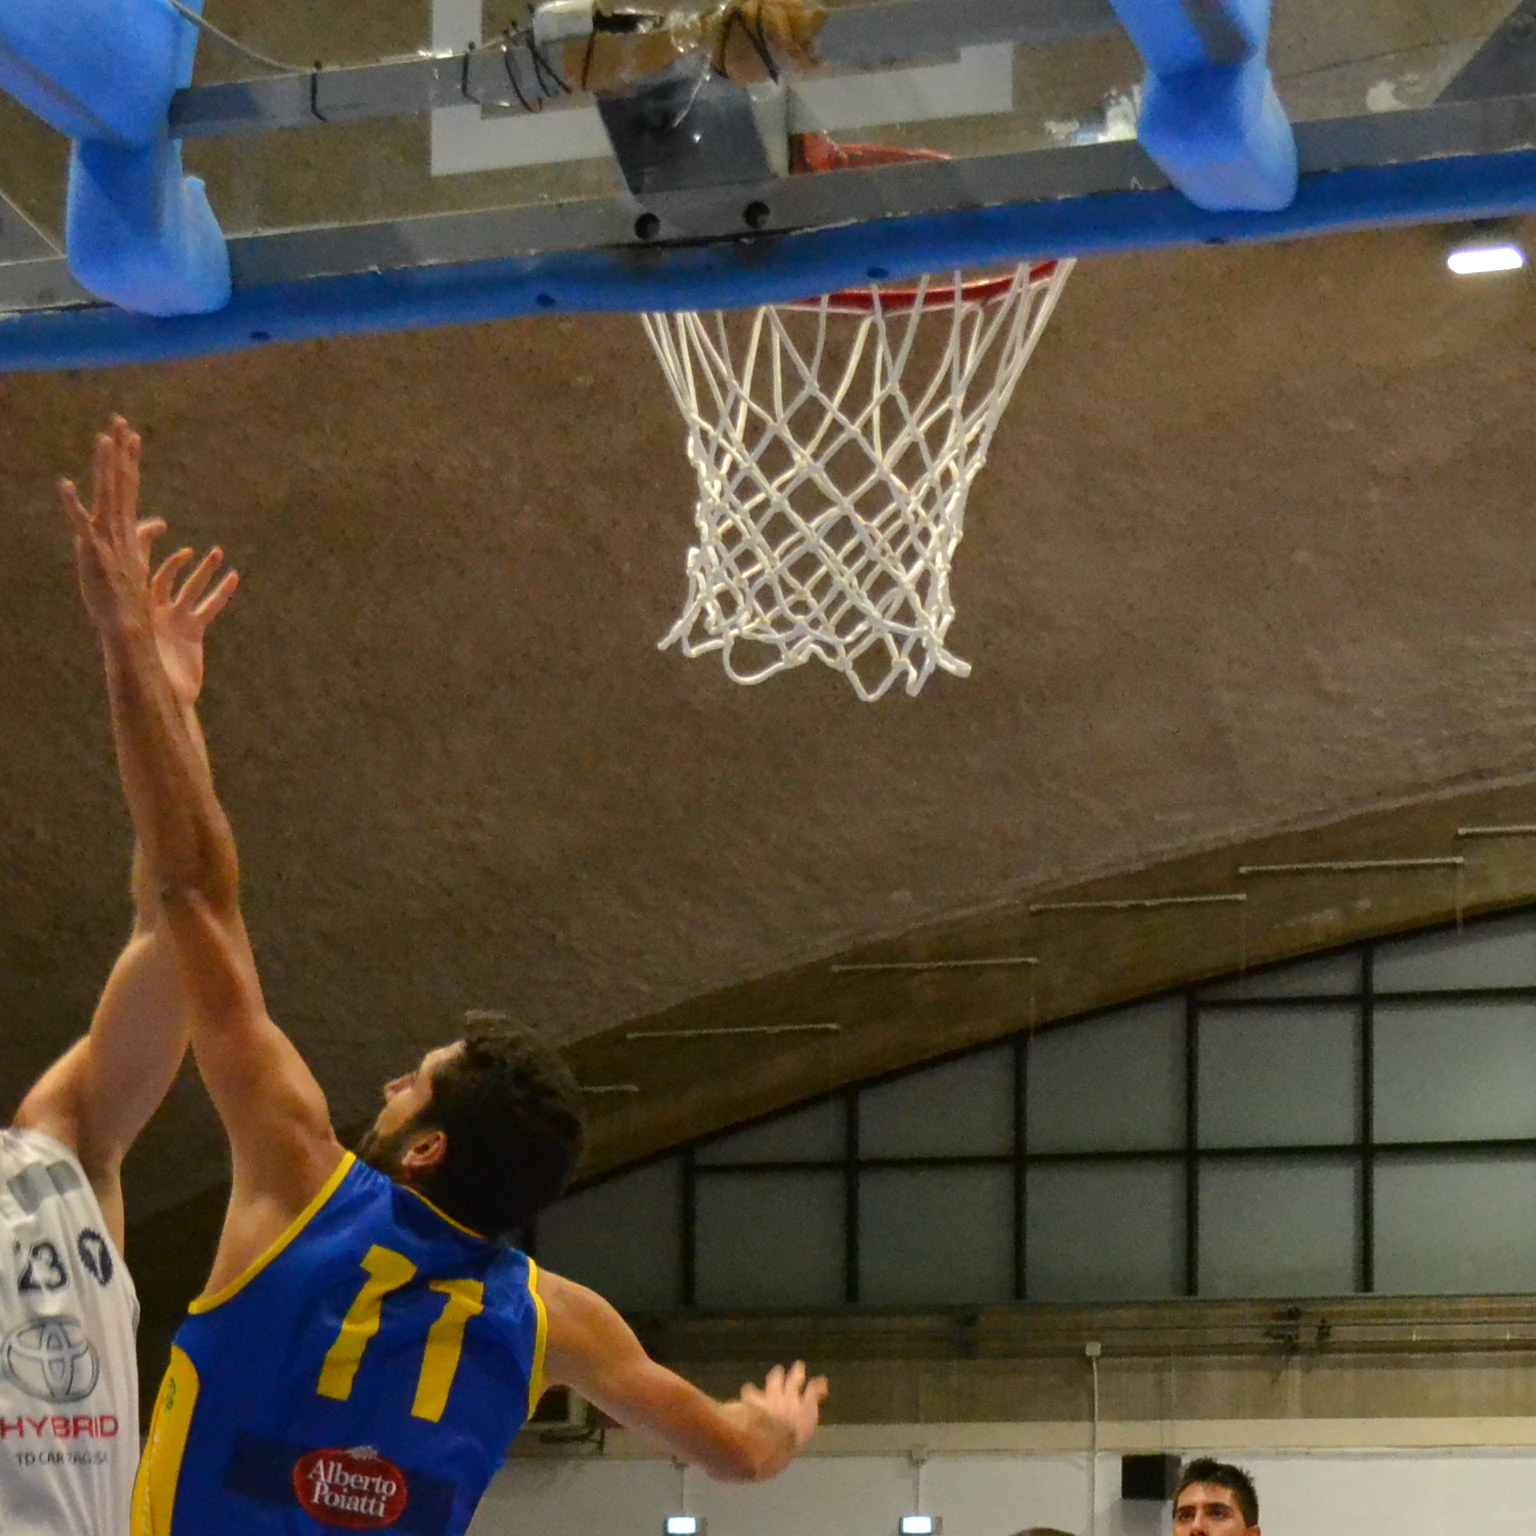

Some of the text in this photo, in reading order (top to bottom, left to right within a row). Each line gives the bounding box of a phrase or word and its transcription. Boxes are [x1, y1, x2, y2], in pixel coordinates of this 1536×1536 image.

[315, 1245, 484, 1423] 11
[307, 1458, 397, 1497] Alberto
[312, 1481, 387, 1518] Poiatti
